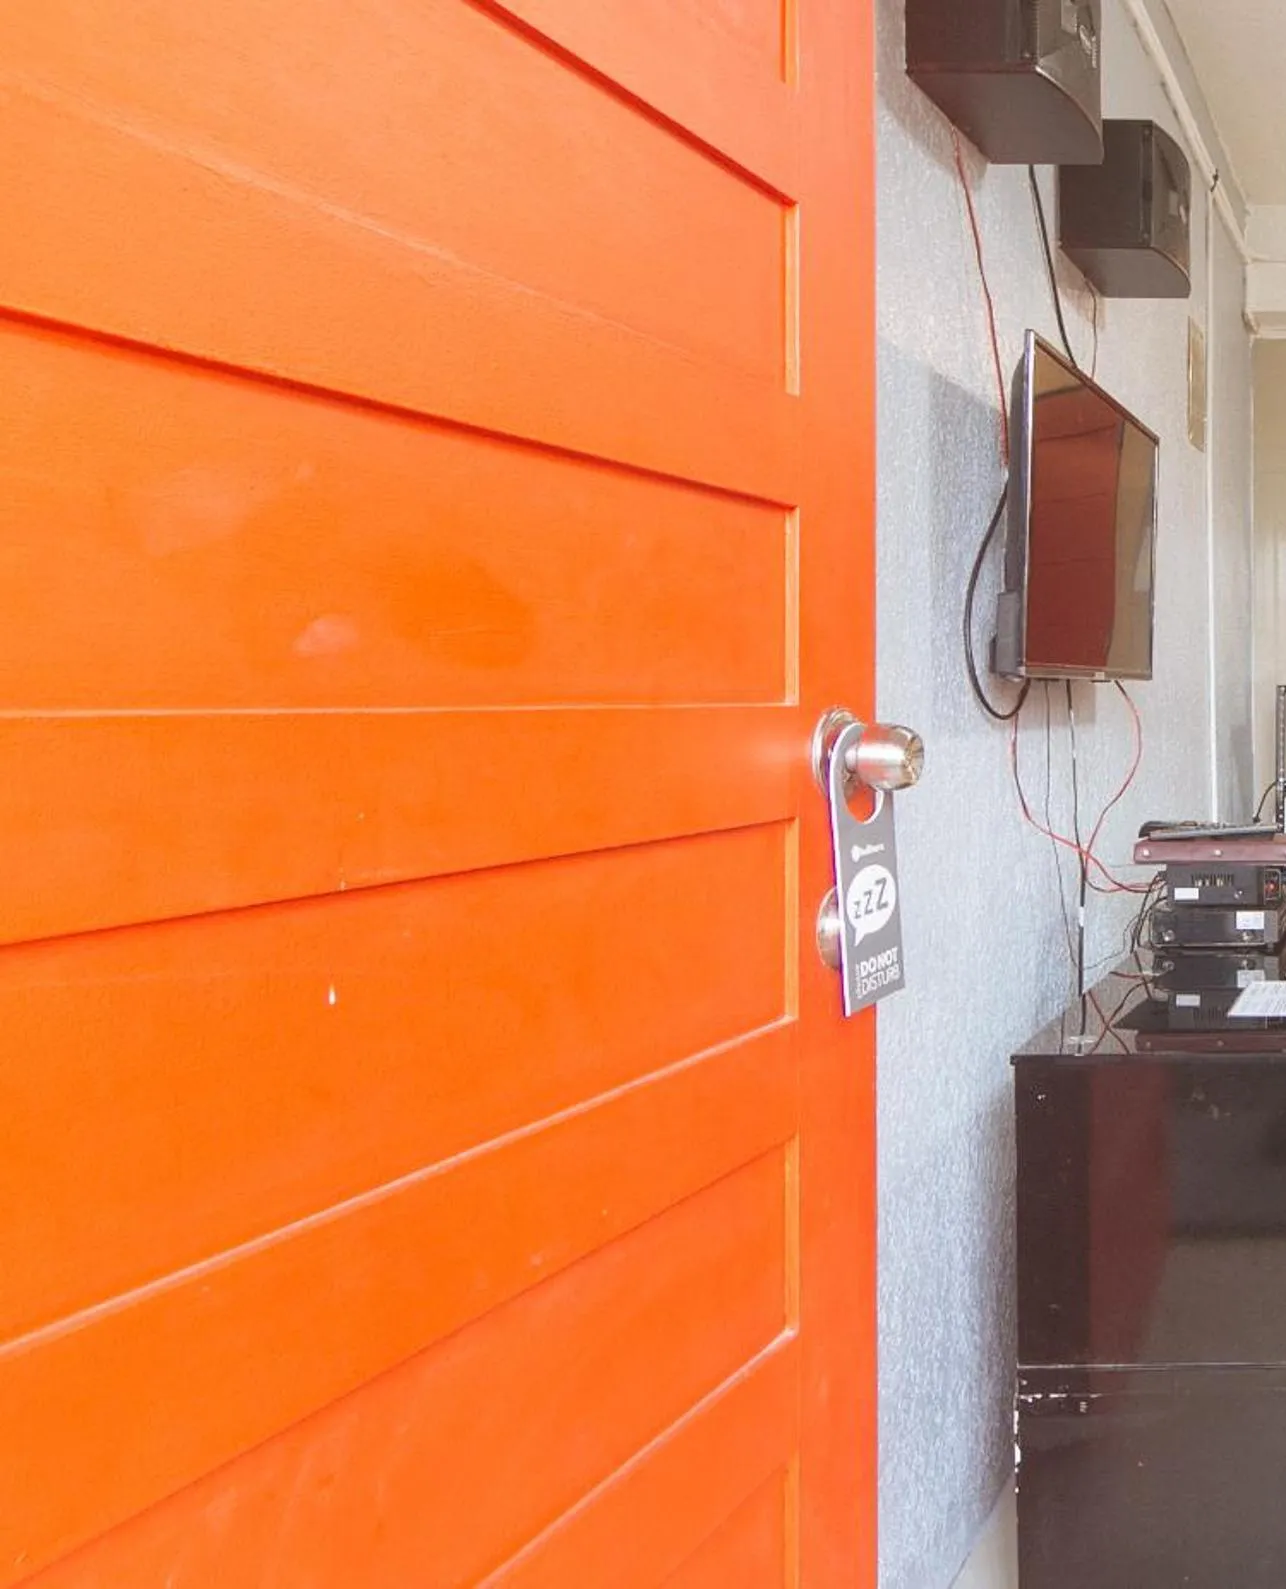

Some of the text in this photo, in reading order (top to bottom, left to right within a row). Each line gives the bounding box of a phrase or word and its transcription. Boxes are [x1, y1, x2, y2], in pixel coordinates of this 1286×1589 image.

[860, 947, 898, 978] DO NOT
[861, 963, 901, 996] DISTURB
